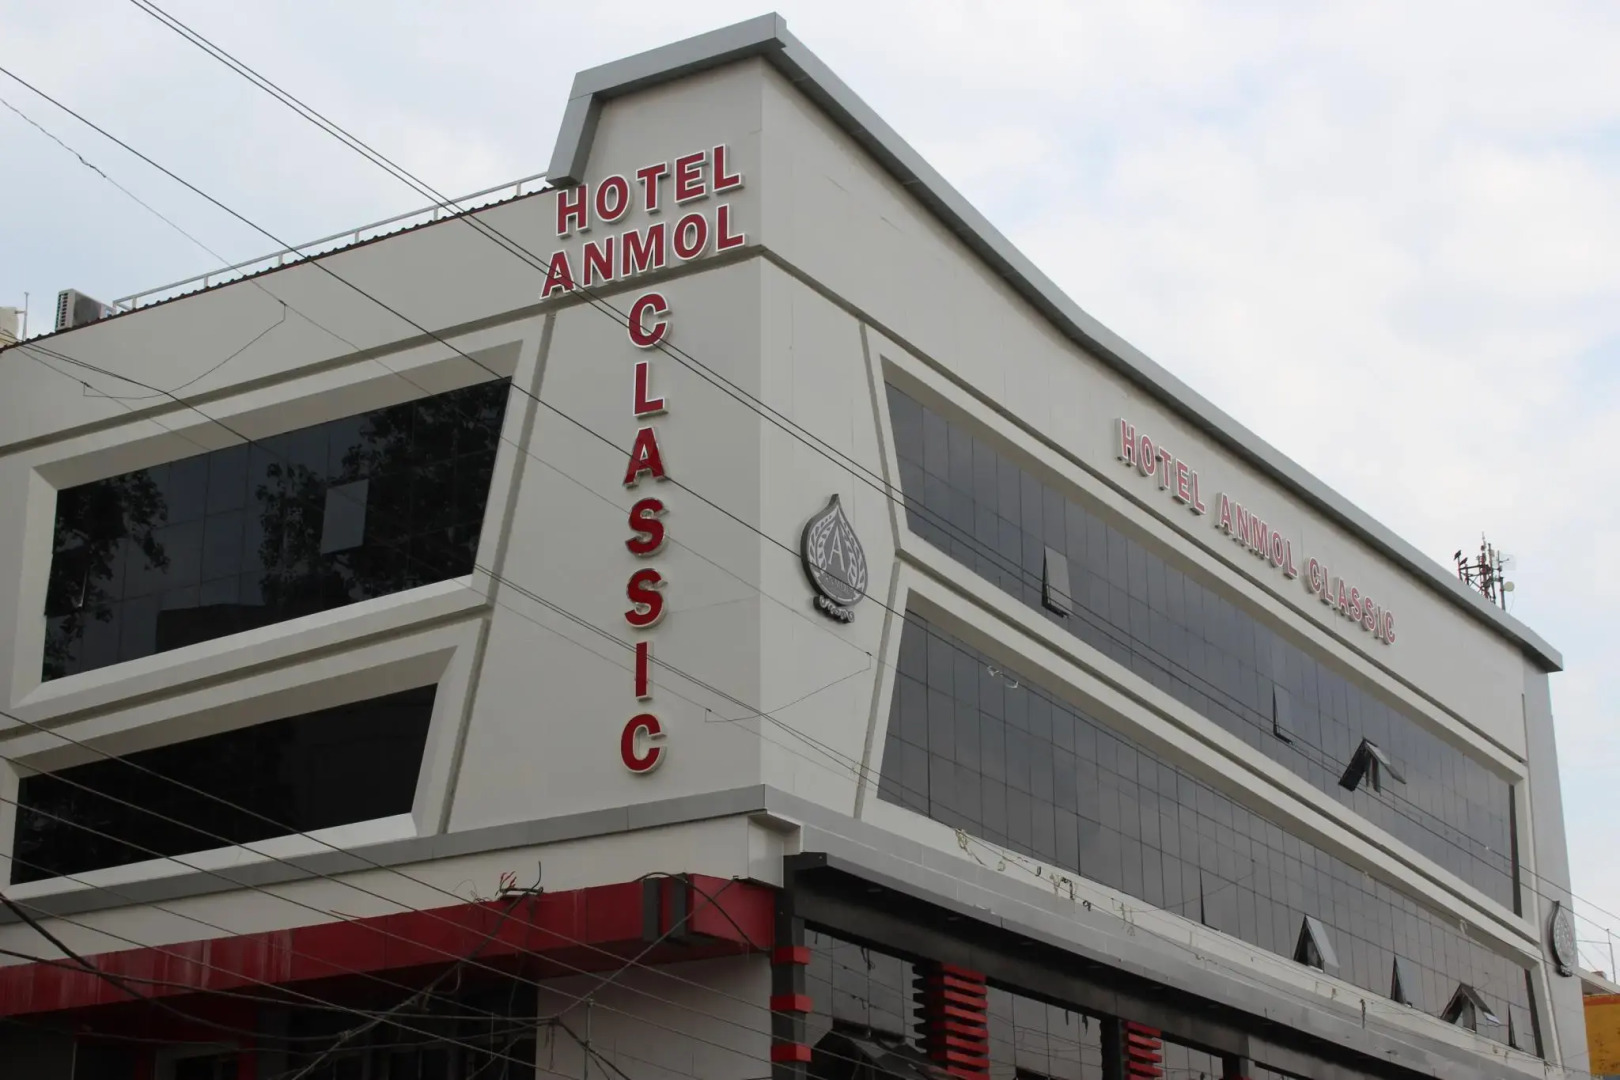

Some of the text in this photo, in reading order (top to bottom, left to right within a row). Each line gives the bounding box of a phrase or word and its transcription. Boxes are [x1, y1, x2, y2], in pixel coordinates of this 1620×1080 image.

[556, 143, 744, 237] HOTEL
[540, 203, 745, 299] ANMOL
[620, 292, 669, 775] CLASSIC
[828, 525, 845, 572] A
[1116, 417, 1396, 645] HOTEL ANMOL CLASSIC
